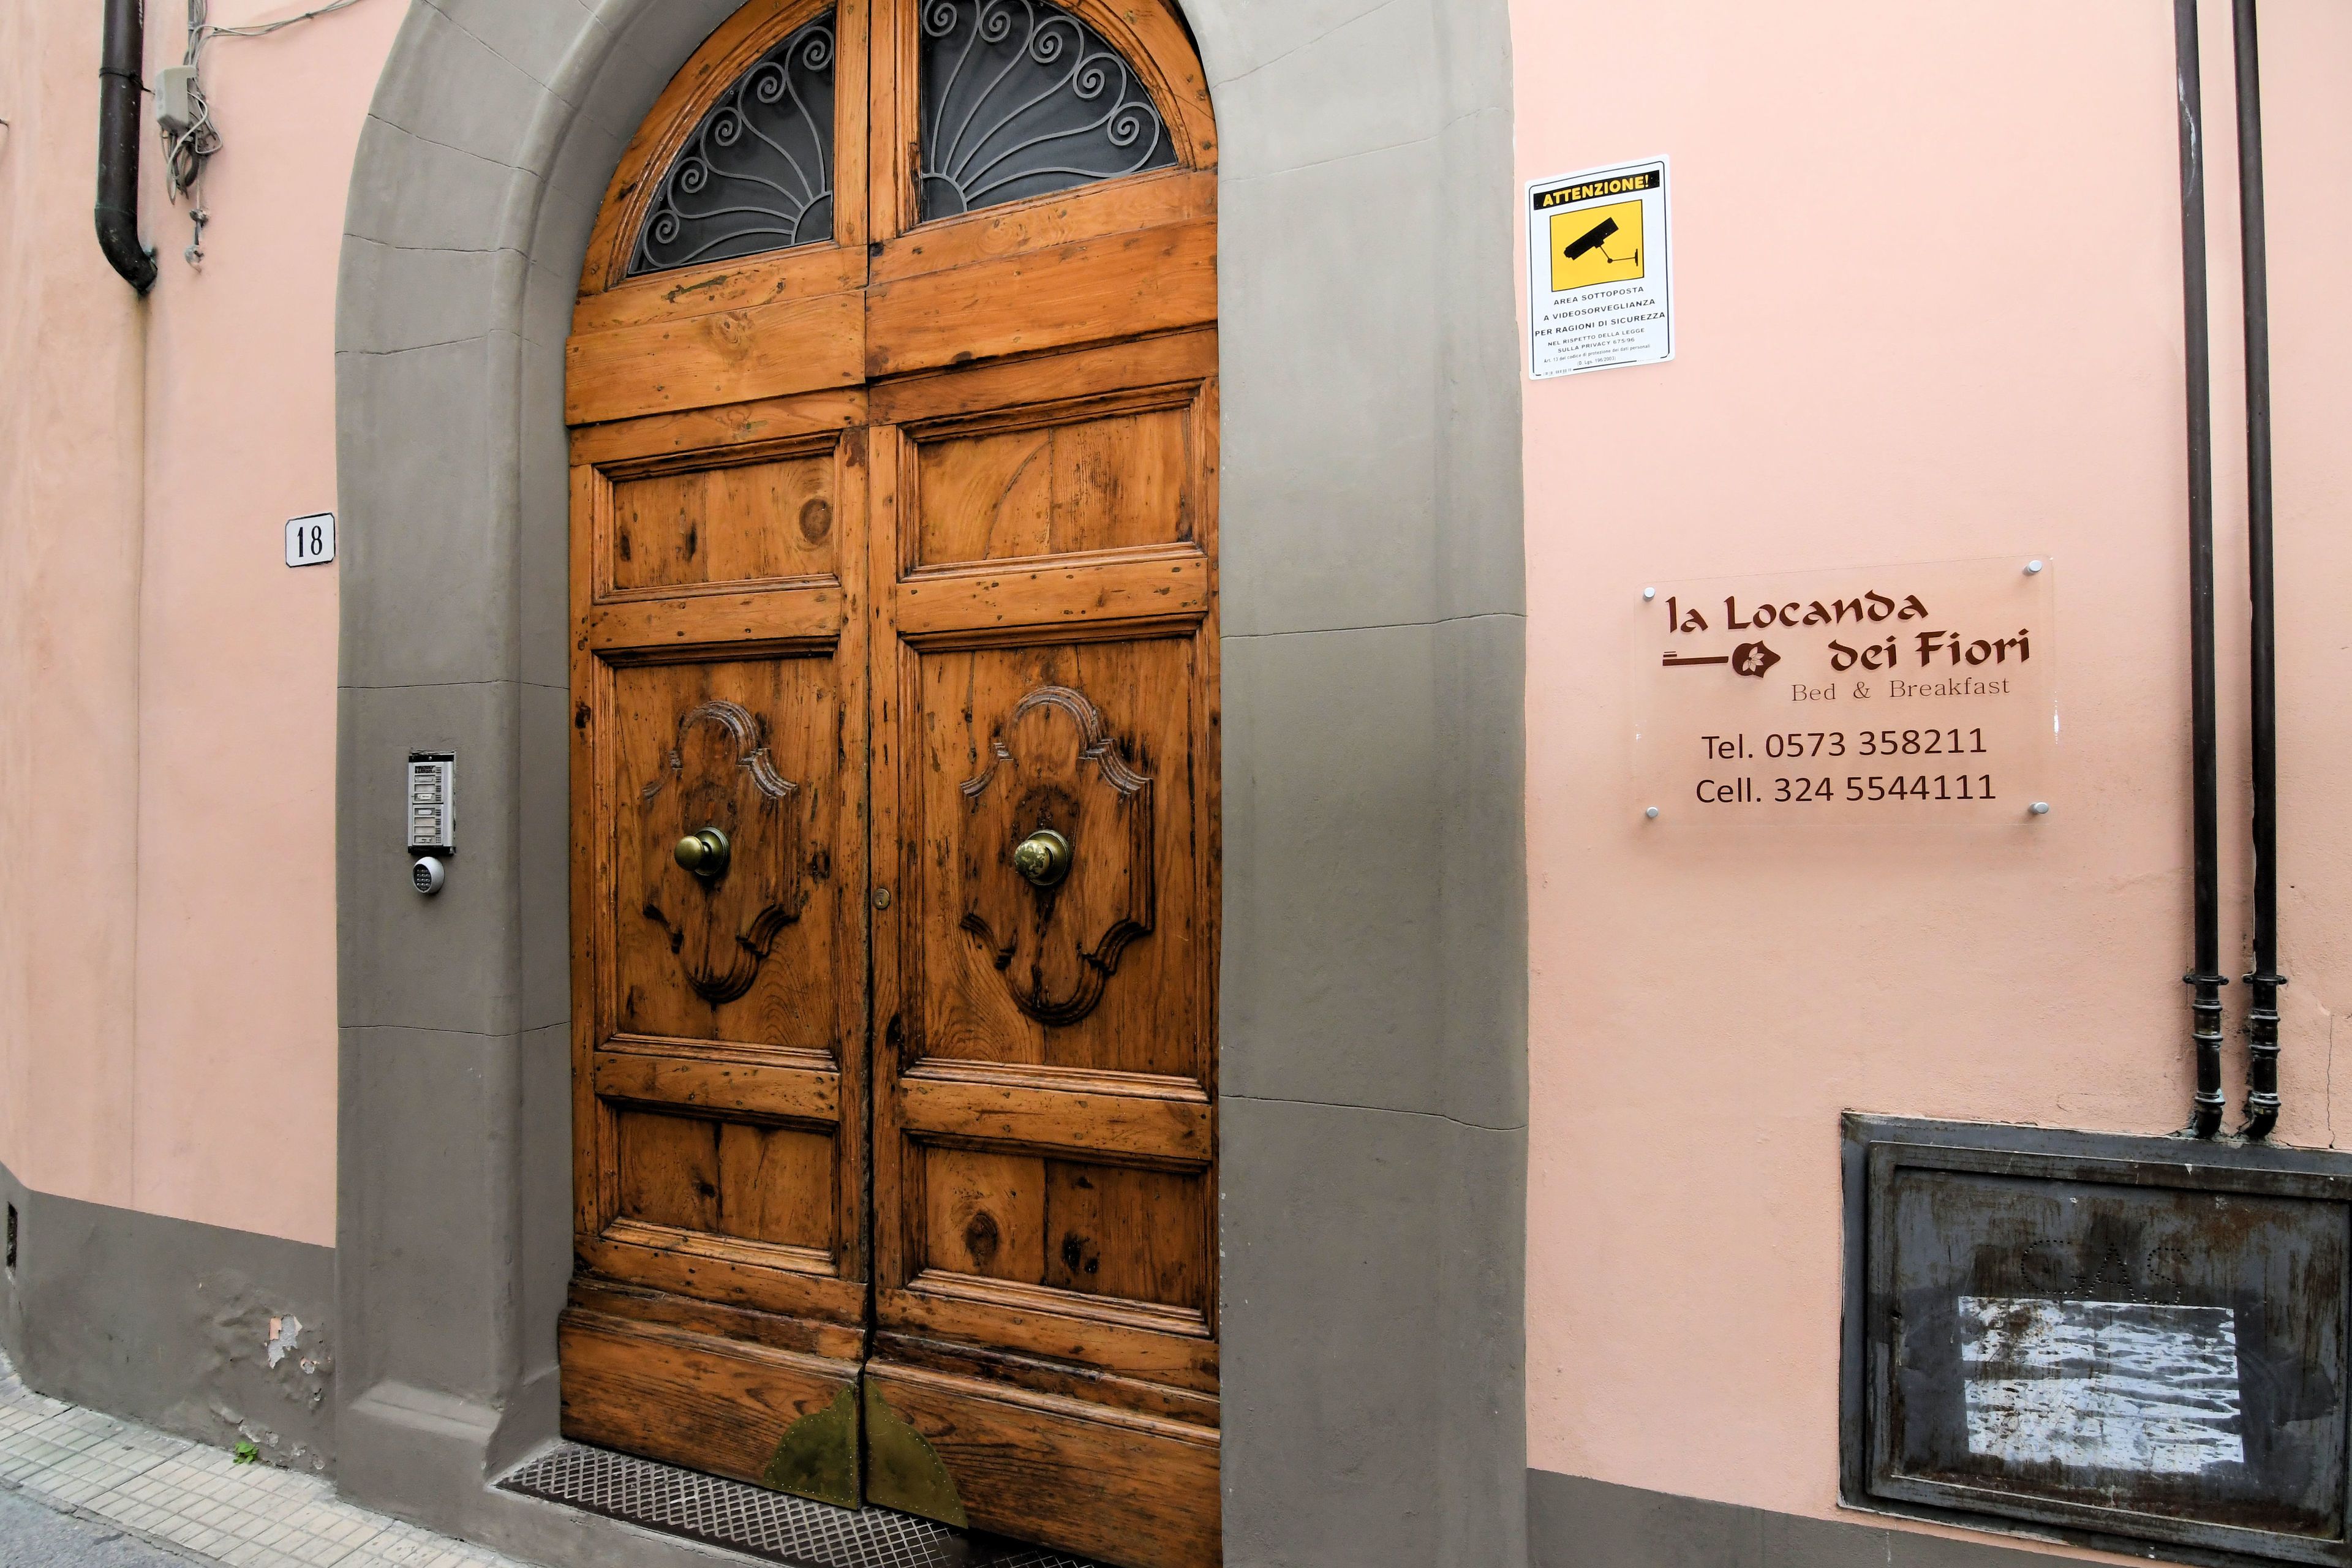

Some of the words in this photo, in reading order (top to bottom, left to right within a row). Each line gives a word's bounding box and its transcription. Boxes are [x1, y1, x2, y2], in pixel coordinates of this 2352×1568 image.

[1543, 174, 1649, 207] ATTENZIONE!
[1553, 296, 1578, 306] AREA
[1581, 286, 1644, 301] SOTTOPOSTA
[1553, 298, 1656, 320] VIDEOSORVEGLIANZA
[1535, 328, 1553, 337] PER
[1556, 322, 1595, 334] RAGIONI
[1611, 312, 1665, 325] SICUREZZA
[1562, 334, 1596, 344] RISPETTO
[1581, 341, 1611, 349] PRIVACY
[297, 525, 323, 557] 18
[1665, 595, 1709, 633] la
[1723, 589, 1929, 630] Locanda
[1828, 635, 1898, 672] dei
[1914, 627, 2031, 668] Fiori
[1791, 683, 1837, 702] Bed
[1853, 681, 1871, 699] &
[1889, 676, 2011, 698] Breakfast
[1702, 734, 1754, 760] Tel.
[1766, 732, 1846, 759] 0573
[1859, 728, 1988, 756] 358211
[1696, 777, 1762, 804] Cell.
[1774, 777, 1834, 803] 324
[1846, 774, 1997, 802] 5544111
[2021, 1240, 2187, 1305] GAS
